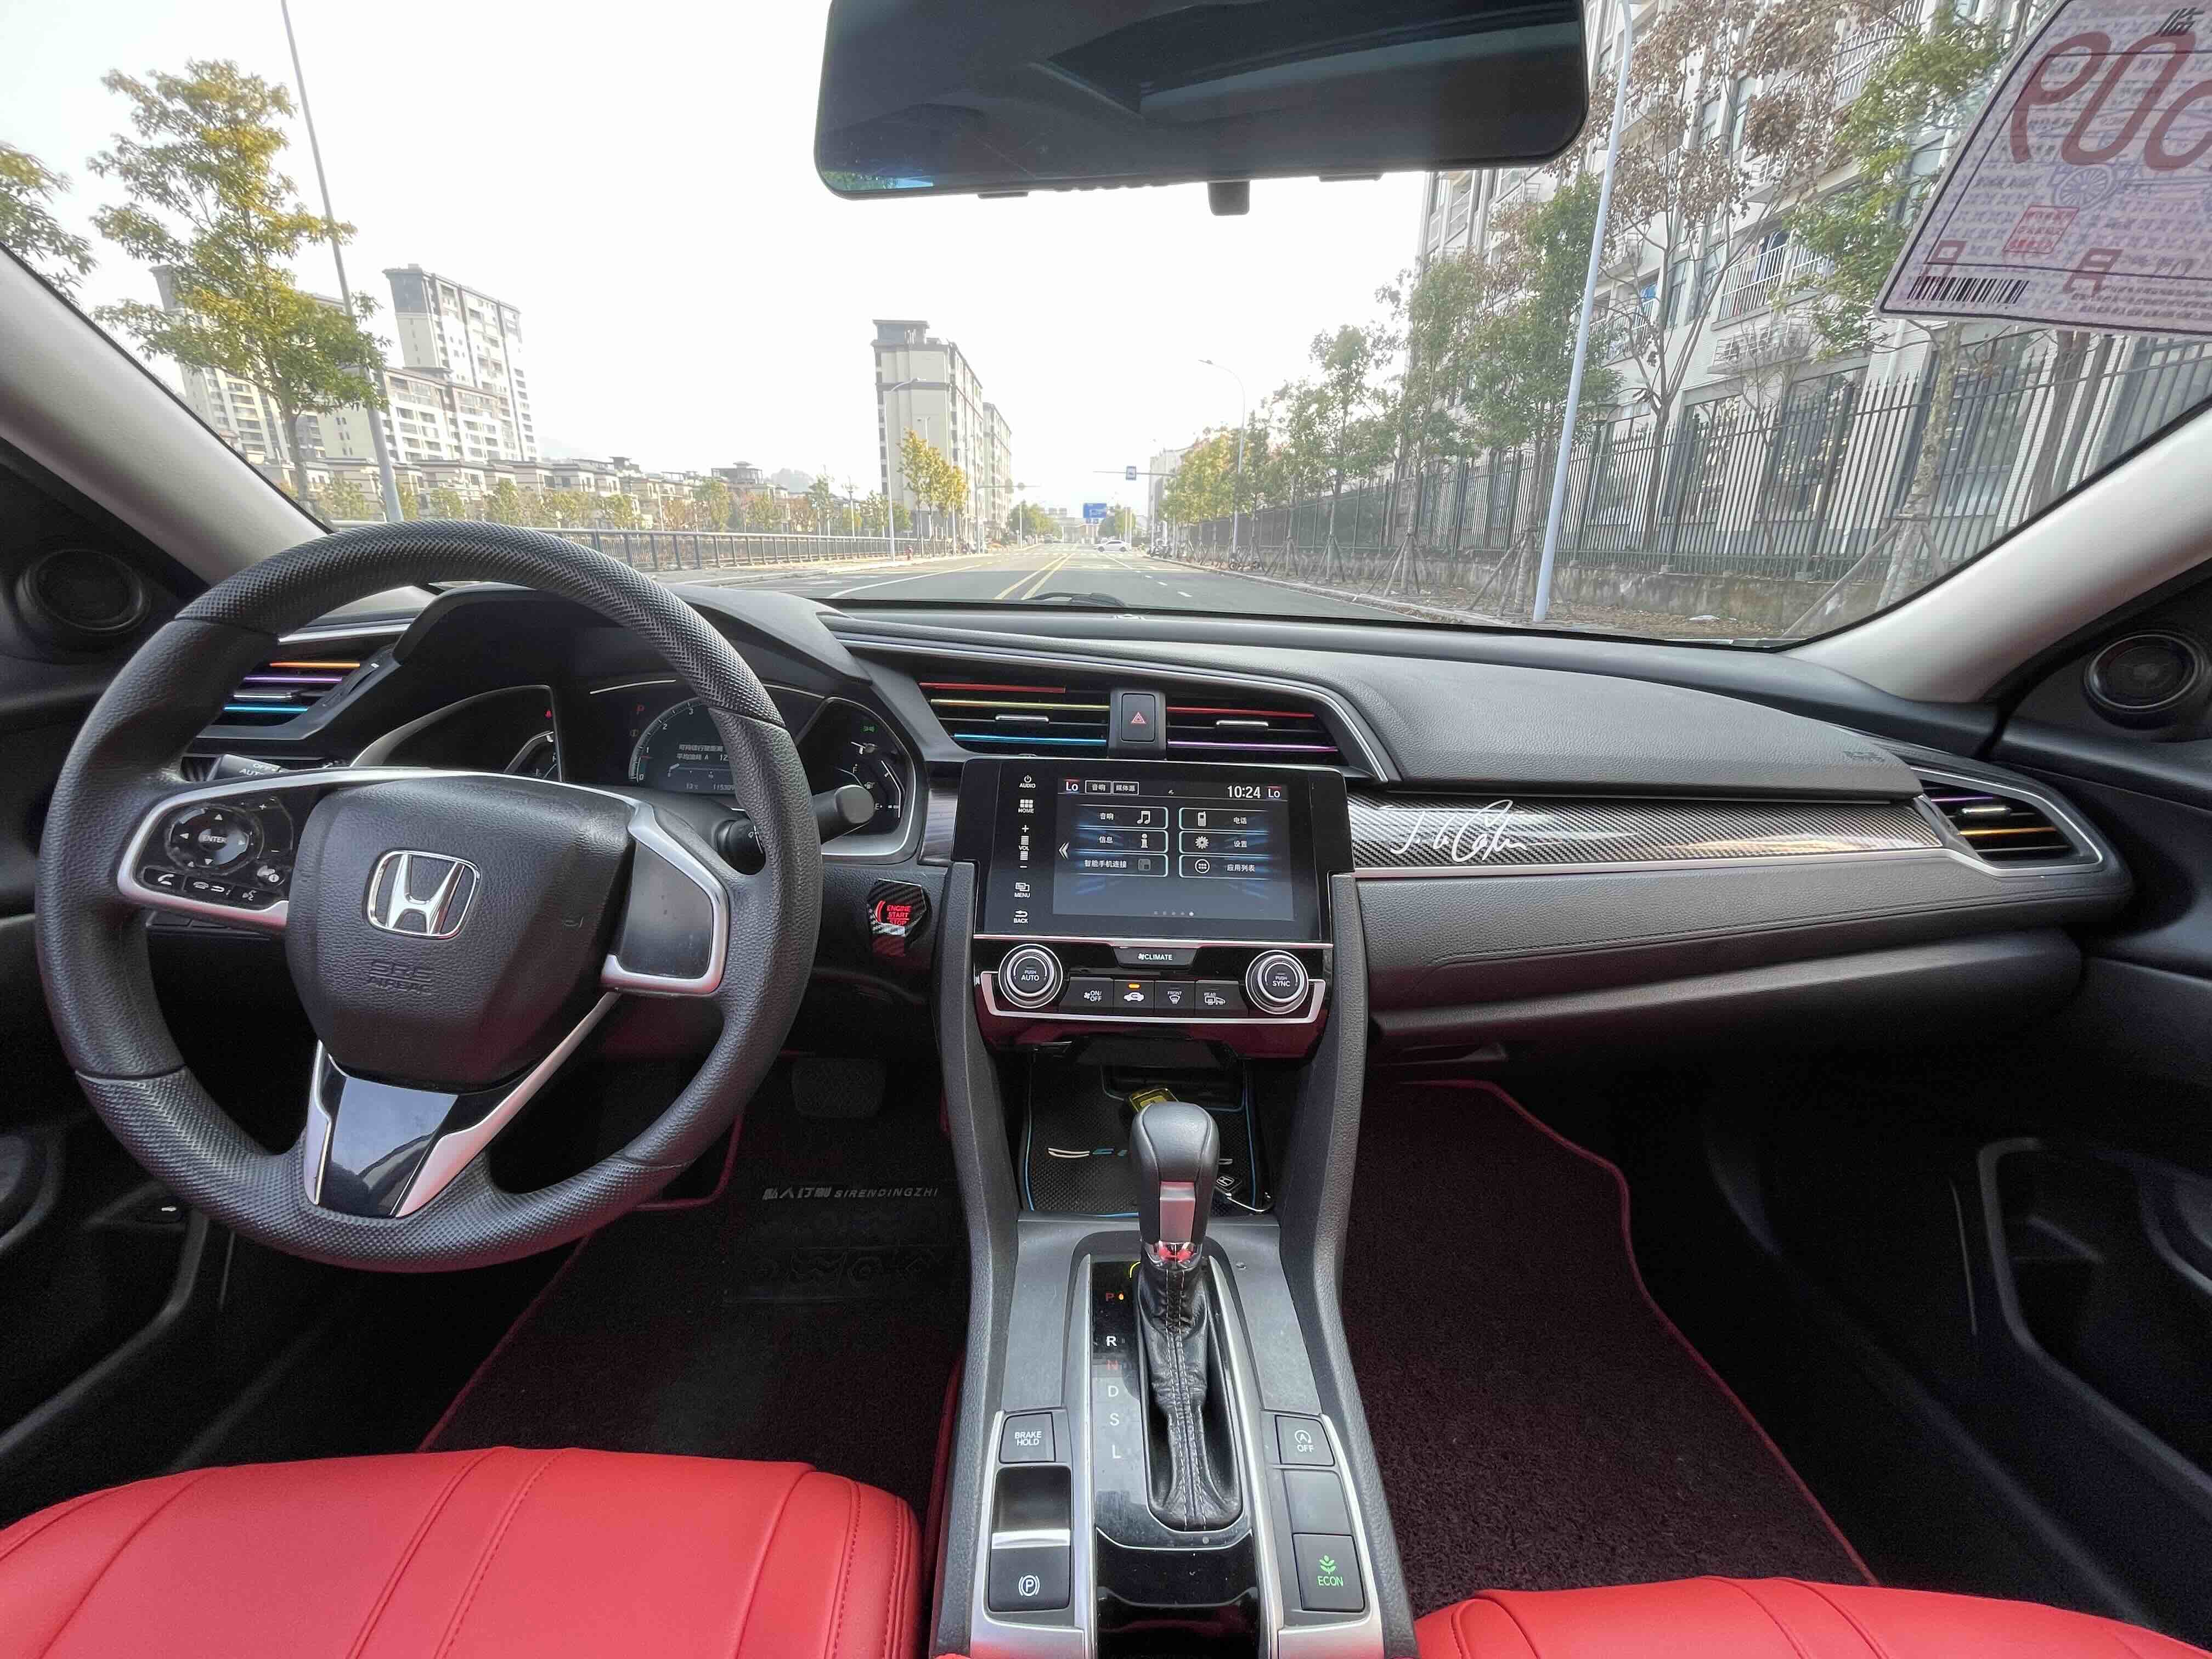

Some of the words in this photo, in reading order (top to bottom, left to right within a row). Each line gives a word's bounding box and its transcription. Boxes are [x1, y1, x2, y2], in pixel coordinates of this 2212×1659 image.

[1066, 781, 1079, 792] Lo
[1227, 785, 1261, 799] 10:24
[1268, 788, 1280, 798] Lo
[1099, 812, 1114, 820] 音响
[1233, 816, 1247, 825] 电话
[1099, 836, 1113, 844] 信息
[1234, 840, 1248, 848] 设置
[1084, 859, 1127, 868] 智能手机连接
[1227, 864, 1256, 872] 应用列表
[833, 1187, 939, 1199] SIRENDINGZHI
[1105, 1293, 1114, 1301] P
[1105, 1335, 1118, 1347] R
[1108, 1385, 1119, 1397] D
[1109, 1413, 1120, 1426] S
[1014, 1430, 1042, 1439] BRAKE
[1017, 1438, 1040, 1446] HOLD
[1111, 1444, 1122, 1459] L
[1296, 1444, 1315, 1453] OFF
[1317, 1576, 1344, 1586] ECON
